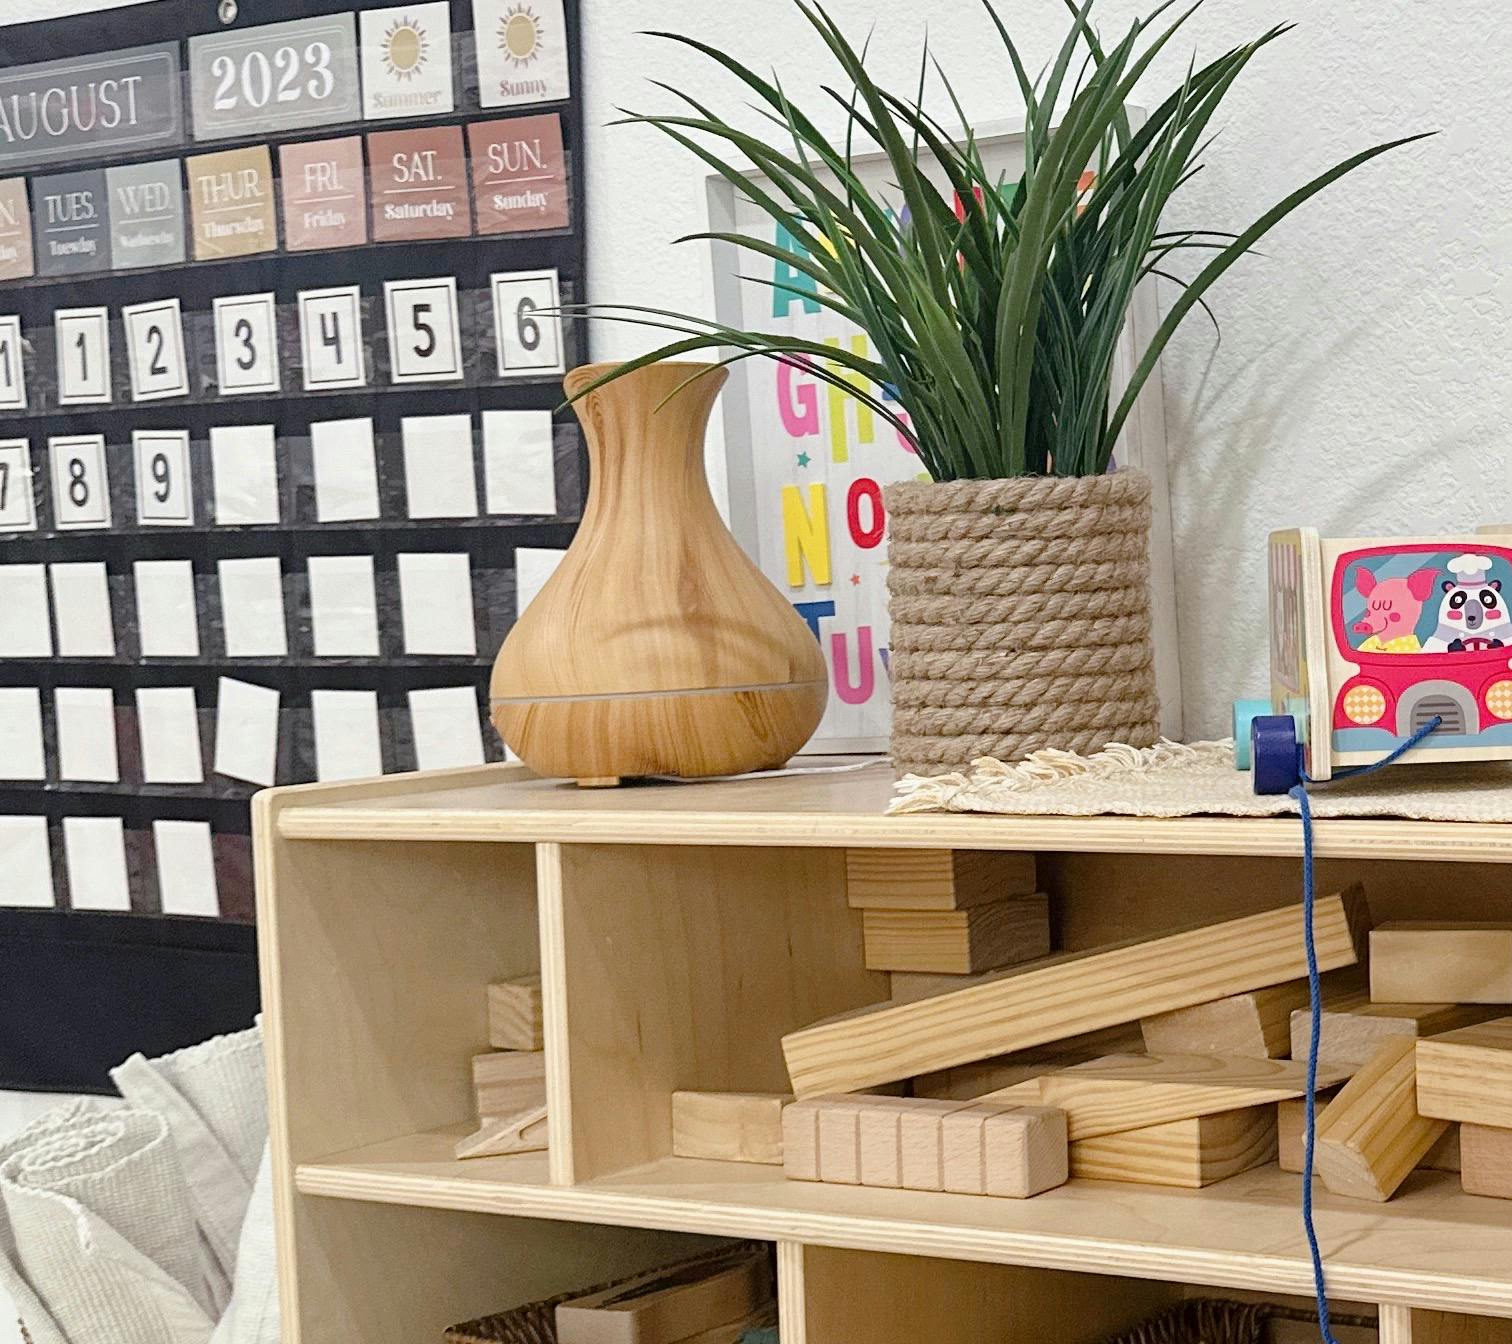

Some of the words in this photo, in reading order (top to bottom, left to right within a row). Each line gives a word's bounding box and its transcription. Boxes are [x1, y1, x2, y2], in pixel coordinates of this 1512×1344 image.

[211, 42, 336, 111] 2023
[500, 79, 548, 97] Sunny
[373, 89, 442, 108] Summer
[392, 150, 443, 183] SAT.
[488, 139, 547, 174] SUN.
[44, 191, 98, 223] TUES.
[384, 199, 454, 220] Saturday
[493, 190, 547, 212] Sunday
[304, 209, 346, 230] Friday
[773, 212, 822, 318] A
[76, 332, 88, 381] 1
[146, 324, 168, 377] 2
[234, 318, 257, 370] 3
[320, 311, 343, 365] 4
[412, 303, 436, 358] 5
[517, 296, 542, 352] 6
[777, 352, 819, 437] G
[824, 334, 875, 464] H
[69, 458, 89, 507] 8
[152, 452, 171, 504] 9
[781, 483, 832, 587] N
[847, 478, 885, 549] O
[831, 626, 875, 705] U
